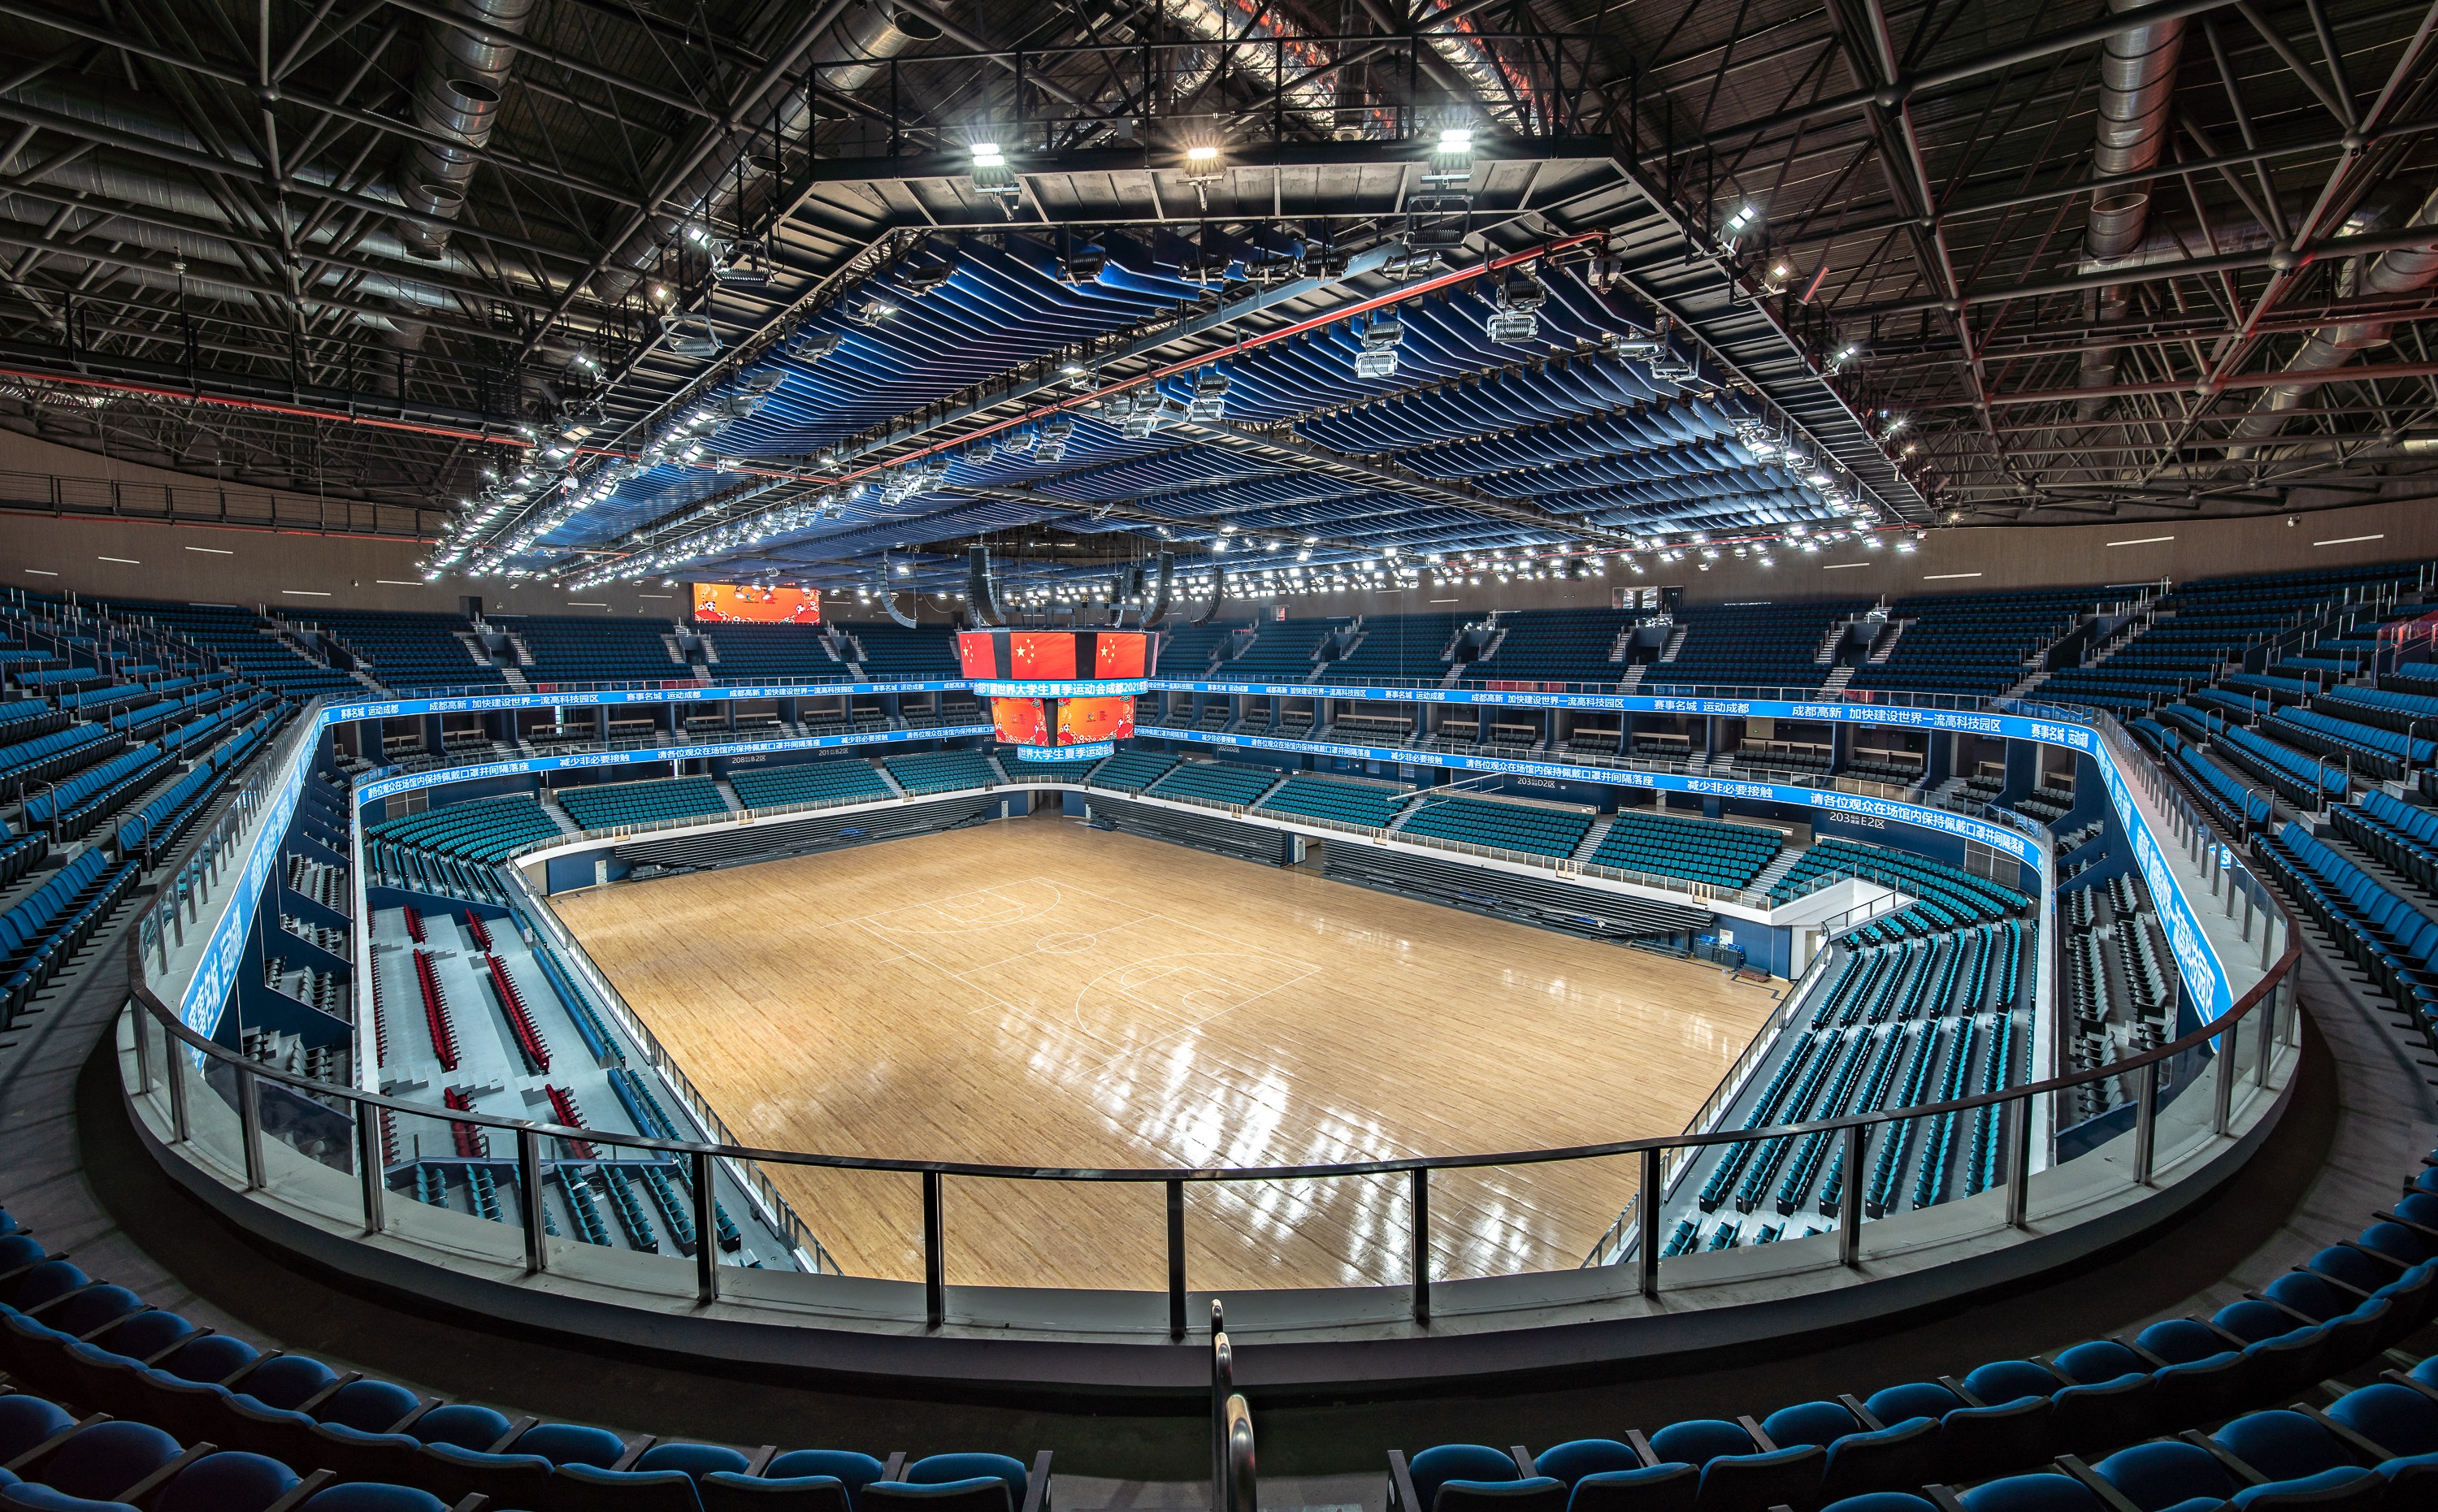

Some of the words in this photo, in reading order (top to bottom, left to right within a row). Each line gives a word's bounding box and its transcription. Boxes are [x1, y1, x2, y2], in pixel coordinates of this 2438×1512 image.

[730, 688, 761, 697] 成都高新
[764, 686, 853, 695] 加快建设世界一流高科技园区
[873, 683, 897, 691] 赛事名城
[1208, 684, 1226, 692] 赛事名城
[1229, 684, 1248, 692] 运动成都
[1266, 686, 1287, 694] 成都高新
[1291, 687, 1366, 697] 加快建设世界一流高科技园区
[429, 700, 466, 711] 成都高新
[471, 694, 599, 708] 加快建设世界一流高科技园区
[627, 692, 662, 700] 赛事名城
[667, 691, 701, 699] 运动成都
[1385, 690, 1412, 699] 赛事名城
[1416, 691, 1445, 701] 运动成都
[1471, 693, 1503, 704] 成都高新
[1508, 695, 1624, 708] 加快建设世界一流高科技园区
[341, 706, 364, 720] 赛事名城
[368, 704, 398, 715] 运动成都
[1655, 700, 1697, 712] 赛事名城
[1703, 701, 1749, 713] 运动成都
[1793, 705, 1842, 719] 成都高新
[1849, 707, 2001, 732] 加快建设世界一流高科技园区
[841, 734, 888, 744] 减少非必要接触
[1201, 734, 1237, 744] 减少非必要接触
[2032, 723, 2064, 743] 赛事名城
[658, 739, 820, 759] 请各位观众在场馆内保持佩戴口罩并间隔落座
[559, 752, 630, 767] 减少非必要接触
[1391, 752, 1443, 765] 减少非必要接触
[1466, 757, 1654, 786] 请各位观众在场馆内保持佩戴口罩并间隔落座
[1517, 777, 1531, 785] 203
[1538, 778, 1555, 788] D2区
[1687, 779, 1773, 799] 减少非必要接触
[1811, 792, 2025, 856] 请各位观众在场馆内保持佩戴口罩并间隔落座
[1830, 812, 1850, 822] 203
[1861, 817, 1885, 829] E2区
